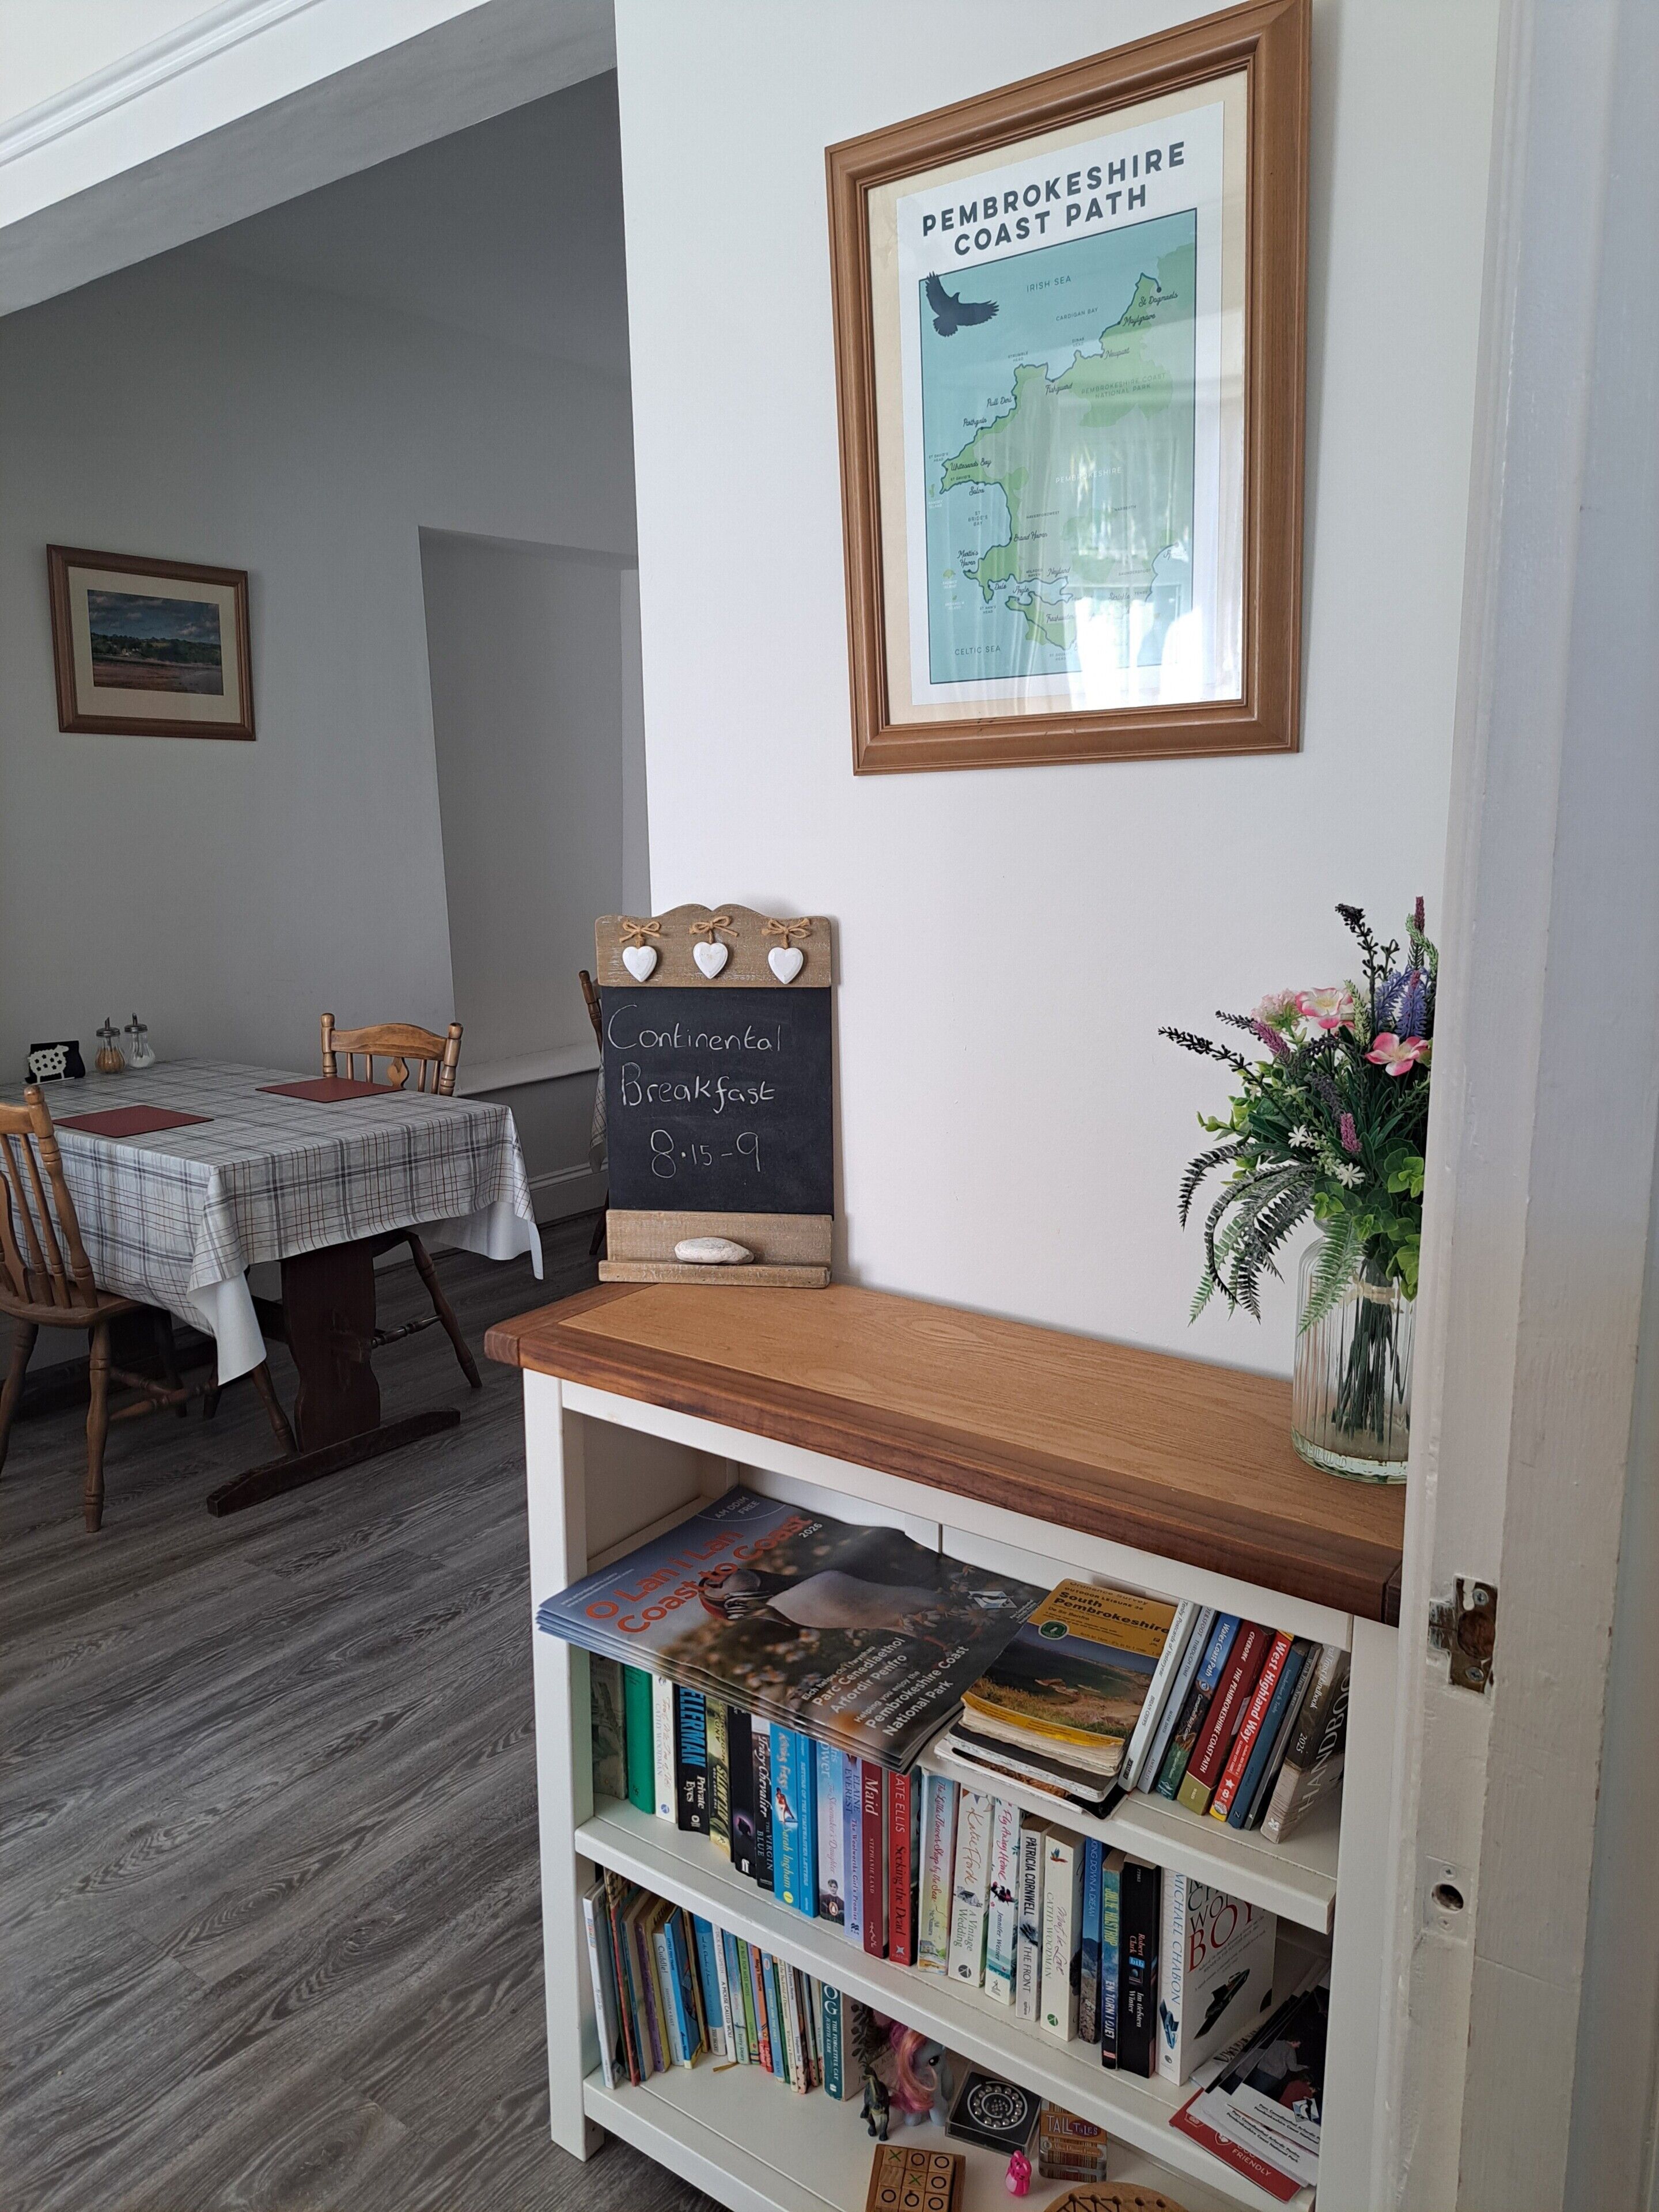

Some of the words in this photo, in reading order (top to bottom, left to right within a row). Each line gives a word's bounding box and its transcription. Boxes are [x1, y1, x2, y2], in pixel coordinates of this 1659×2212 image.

[923, 141, 1185, 236] PEMBROKESHIRE
[955, 211, 1050, 256] COAST
[1066, 184, 1146, 227] PATH
[1027, 281, 1050, 293] IRISH
[1054, 275, 1071, 286] SEA
[1138, 296, 1147, 308] St
[1148, 291, 1178, 305] Dogmaels
[1056, 310, 1085, 321] CARDIGAN
[1045, 382, 1073, 395] Fishguard
[1081, 378, 1139, 395] PEMBROKESHIRE
[1143, 373, 1166, 381] COAST
[1095, 388, 1129, 399] NATIONAL
[1132, 383, 1151, 392] PARK
[980, 457, 991, 468] Bay
[1056, 466, 1122, 483] PEMBROKESHIRE
[957, 550, 978, 559] Martin's
[960, 559, 976, 569] Haven
[1047, 567, 1070, 578] Neyland
[1013, 586, 1029, 595] Angle
[955, 647, 982, 656] CELTIC
[608, 1004, 781, 1052] Continental
[622, 1062, 775, 1113] Breakfast
[714, 1508, 729, 1519] AM
[726, 1496, 749, 1510] DDIM
[737, 1500, 760, 1515] FREE
[798, 1522, 823, 1538] 2026
[585, 1601, 619, 1619] O
[613, 1566, 680, 1601] Lan
[682, 1530, 744, 1561] Lan
[617, 1579, 703, 1633] Coast
[698, 1562, 738, 1582] to
[733, 1515, 813, 1560] Coast
[1059, 1592, 1103, 1608] South
[1064, 1587, 1100, 1599] OUTDOOR
[1101, 1597, 1132, 1608] LEISURE
[1116, 1594, 1149, 1605] Survey
[1179, 1601, 1188, 1618] Tenby
[1171, 1618, 1183, 1641] Postcards
[1218, 1622, 1230, 1643] Wales
[1189, 1640, 1199, 1665] THROUGH
[1211, 1642, 1222, 1664] Coast
[1241, 1631, 1256, 1662] CICERONE
[1268, 1641, 1287, 1671] West
[801, 1687, 820, 1700] Eich
[815, 1673, 837, 1689] helpu
[848, 1645, 876, 1666] fwynhau
[811, 1685, 842, 1706] Parc
[838, 1637, 906, 1685] Cenedlaethol
[1158, 1650, 1172, 1677] Yesteryear
[1205, 1660, 1217, 1677] Path
[1233, 1667, 1243, 1682] THE
[830, 1679, 874, 1714] Arfordir
[870, 1655, 907, 1680] Penfro
[853, 1700, 882, 1723] Helping
[879, 1690, 893, 1702] you
[892, 1678, 911, 1692] enjoy
[907, 1671, 921, 1680] the
[865, 1669, 942, 1729] Pembrokeshire
[938, 1645, 969, 1669] Coast
[1251, 1670, 1276, 1721] Highland
[1310, 1672, 1327, 1709] Handbook
[882, 1697, 931, 1736] National
[925, 1680, 954, 1699] Park
[1214, 1679, 1239, 1735] PEMBROKESHIRE
[679, 1686, 707, 1768] ELLERMAN
[1240, 1719, 1257, 1743] Way
[754, 1736, 771, 1770] Tracy
[1207, 1734, 1218, 1759] COAST
[1296, 1732, 1308, 1753] 2025
[1199, 1755, 1210, 1774] PATH
[684, 1780, 696, 1802] Eyes
[696, 1775, 707, 1809] Private
[715, 1764, 729, 1824] ATLANTIS
[756, 1764, 772, 1818] Chevalier
[844, 1768, 853, 1814] EVEREST
[865, 1775, 878, 1816] Maid
[827, 1794, 838, 1842] Shoemaker's
[895, 1808, 906, 1834] ELLIS
[966, 1806, 983, 1845] Katie
[1001, 1809, 1014, 1827] Fly
[756, 1830, 765, 1857] BLUE
[782, 1827, 793, 1856] Sarah
[932, 1837, 945, 1865] Shop
[998, 1828, 1011, 1855] Away
[1025, 1836, 1036, 1873] PATRICIA
[827, 1840, 839, 1874] Daughter
[868, 1838, 876, 1876] STEPHANIE
[895, 1844, 907, 1889] Seeking
[998, 1854, 1009, 1882] Home
[781, 1855, 794, 1889] Ingham
[896, 1889, 907, 1904] the
[1024, 1874, 1036, 1916] CORNWELL
[1046, 1892, 1054, 1918] CATHY
[1088, 1890, 1098, 1918] DREAM
[1104, 1888, 1119, 1909] JULIE
[1173, 1874, 1185, 1935] MICHAEL
[895, 1904, 907, 1936] Dead
[953, 1908, 968, 1949] Wedding
[995, 1910, 1003, 1936] Jennifer
[1104, 1908, 1119, 1947] HASTRUP
[966, 1916, 978, 1952] Vintage
[1188, 1900, 1252, 1974] BOY
[658, 1945, 668, 1974] Cuddle!
[994, 1936, 1002, 1961] Weiner
[1024, 1946, 1032, 1959] THE
[1045, 1920, 1054, 1979] WOODMAN
[1022, 1959, 1032, 1993] FRONT
[1105, 1980, 1115, 1993] EN
[1171, 1941, 1183, 2005] CHABON
[1105, 1993, 1115, 2017] TORN
[1128, 1990, 1136, 2013] Winter
[1137, 1992, 1144, 2002] Im
[1136, 2003, 1145, 2028] tiefsten
[1046, 2115, 1073, 2135] TALL
[1232, 2148, 1272, 2176] FRIENDLY
